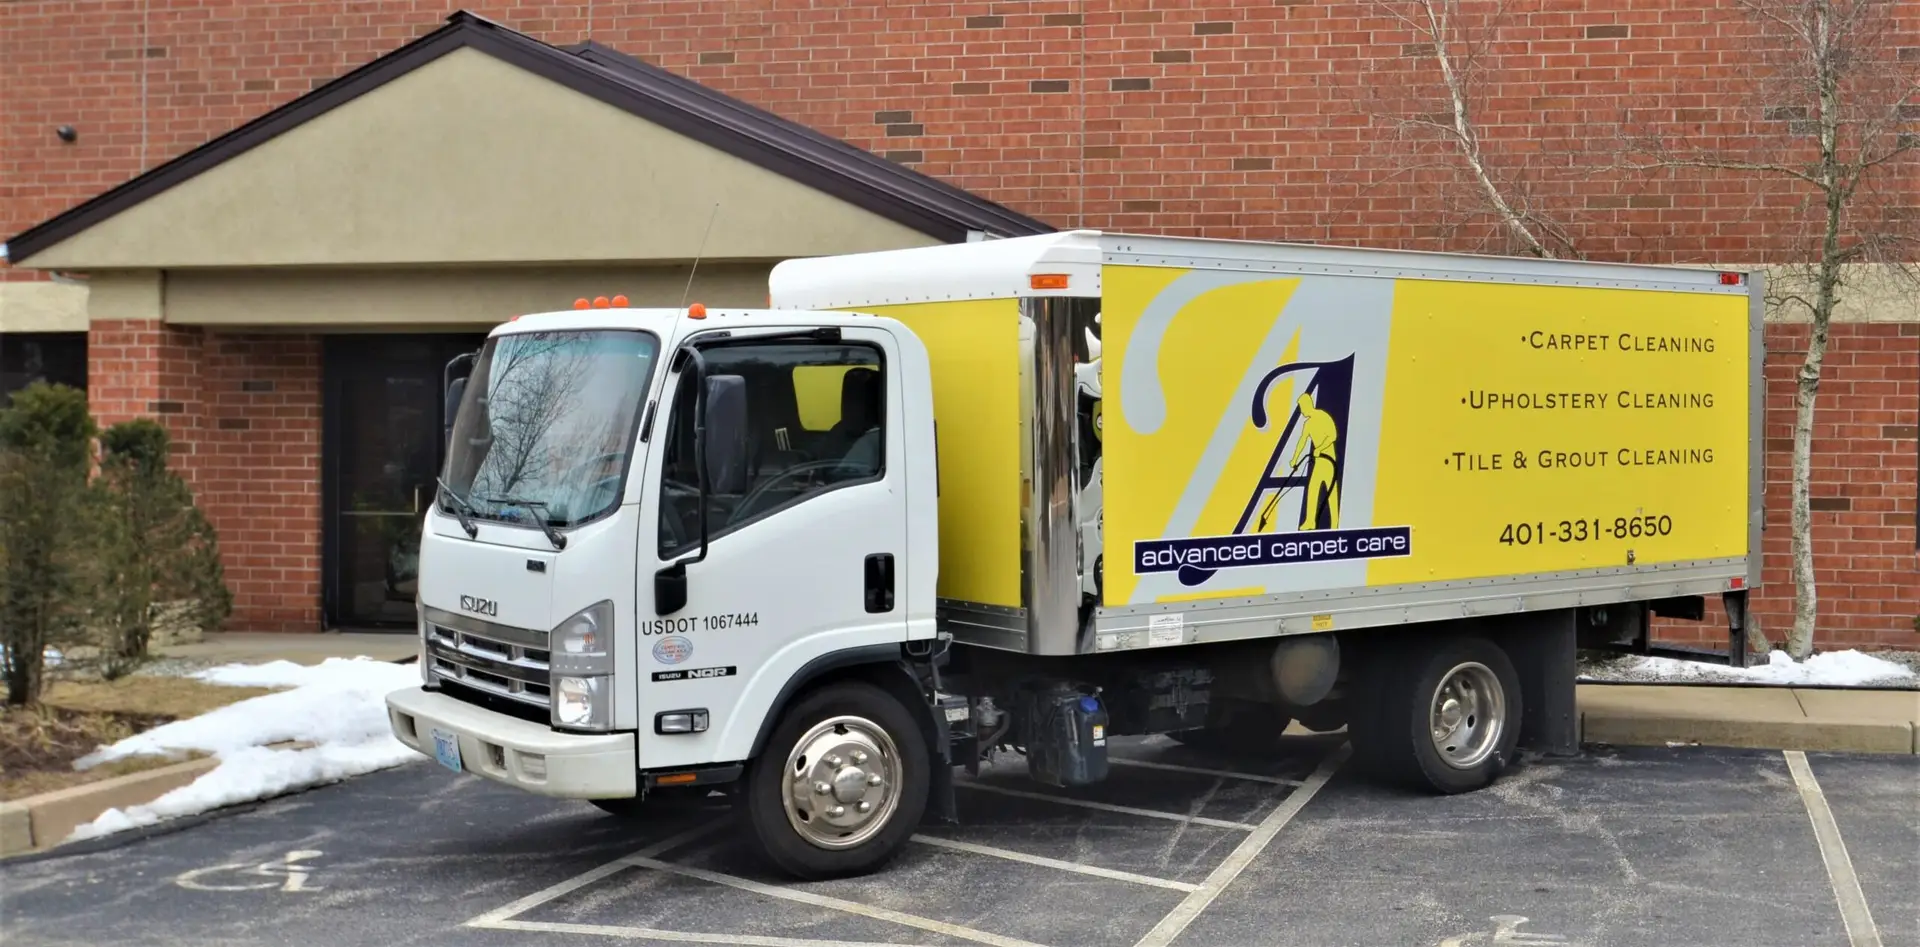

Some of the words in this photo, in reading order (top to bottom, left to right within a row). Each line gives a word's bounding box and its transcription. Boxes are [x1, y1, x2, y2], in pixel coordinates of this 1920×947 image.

[1617, 333, 1715, 353] CLEANING
[1617, 391, 1714, 409] CLEANING
[1513, 450, 1528, 469] &
[1537, 449, 1609, 469] GROUT
[1617, 448, 1714, 466] CLEANING
[1499, 515, 1672, 546] 401-331-8650
[1141, 539, 1262, 567] advanced
[1270, 536, 1348, 560] carpet
[1356, 535, 1406, 552] care
[460, 593, 498, 617] ISUZU
[641, 617, 698, 636] USDOT
[703, 611, 759, 631] 1067444
[658, 672, 682, 680] ISUZU
[687, 667, 728, 679] NQR
